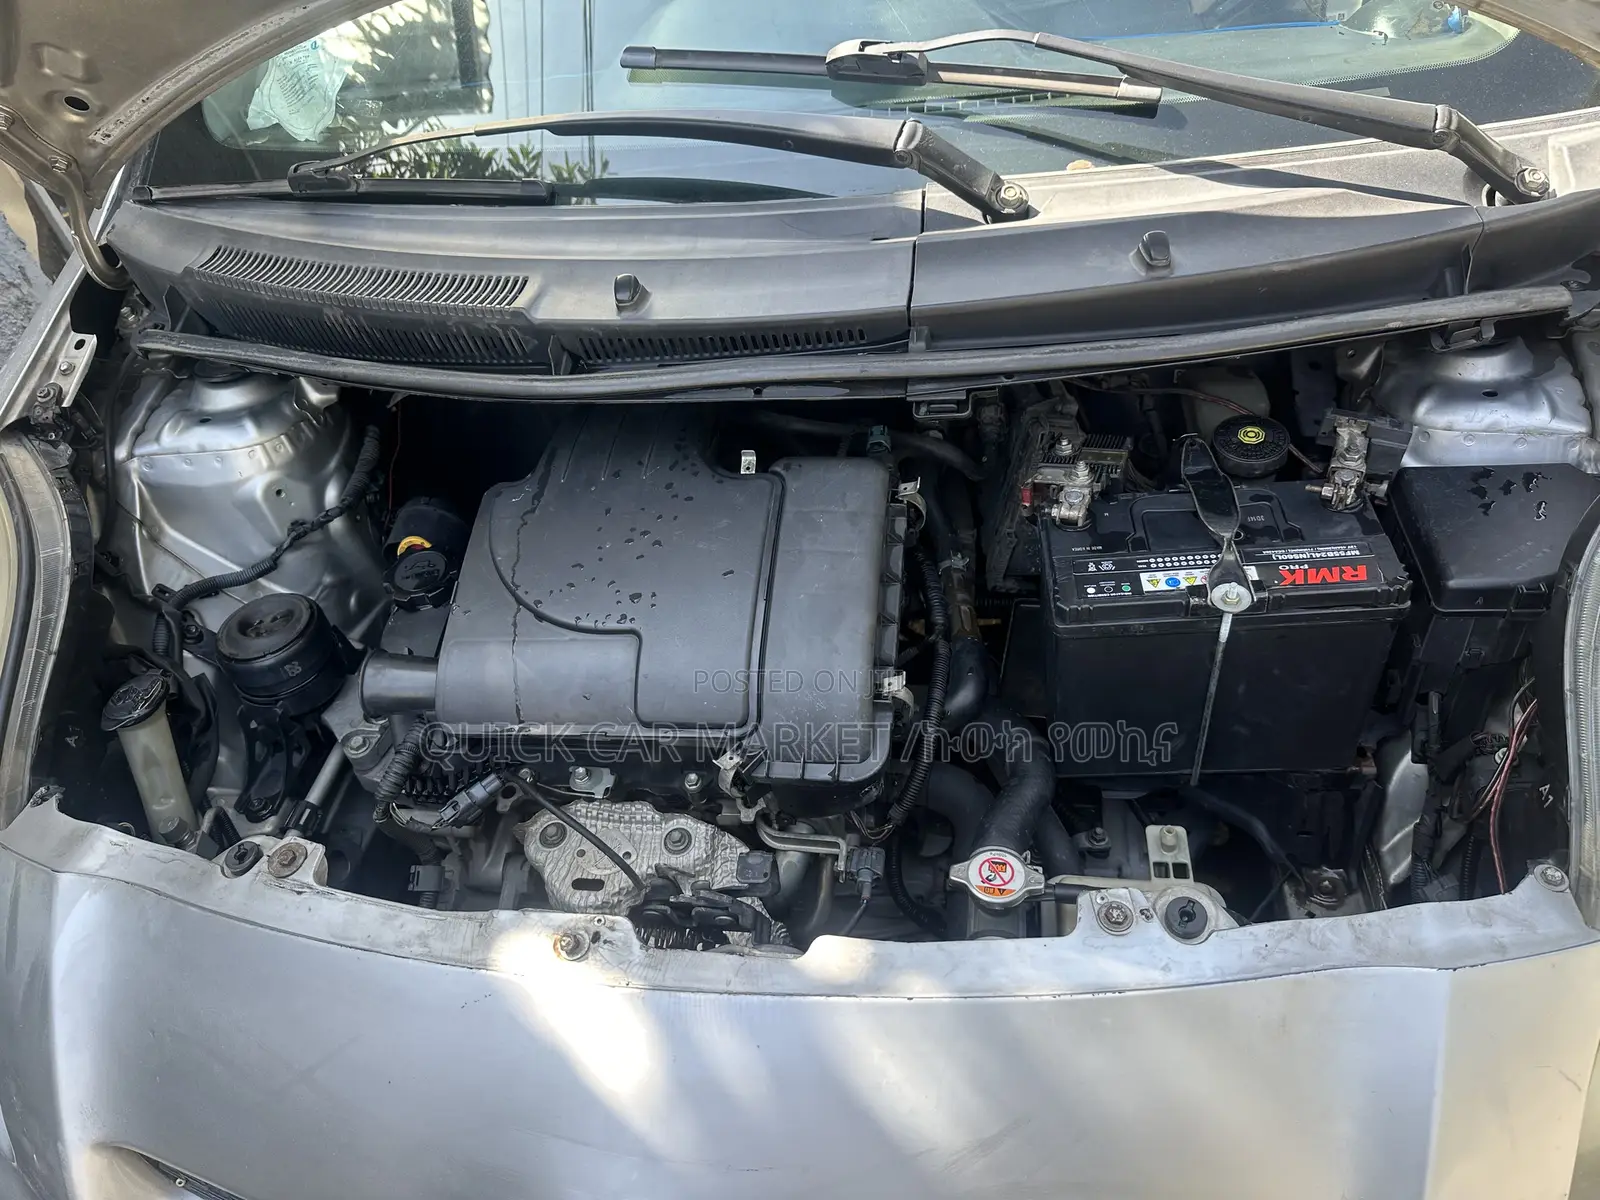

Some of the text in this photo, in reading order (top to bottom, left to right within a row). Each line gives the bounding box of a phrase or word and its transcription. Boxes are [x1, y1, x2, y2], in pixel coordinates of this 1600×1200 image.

[1272, 550, 1361, 560] MF55B24L(NS60L)
[1278, 563, 1309, 571] PRO
[1279, 565, 1367, 585] RMK
